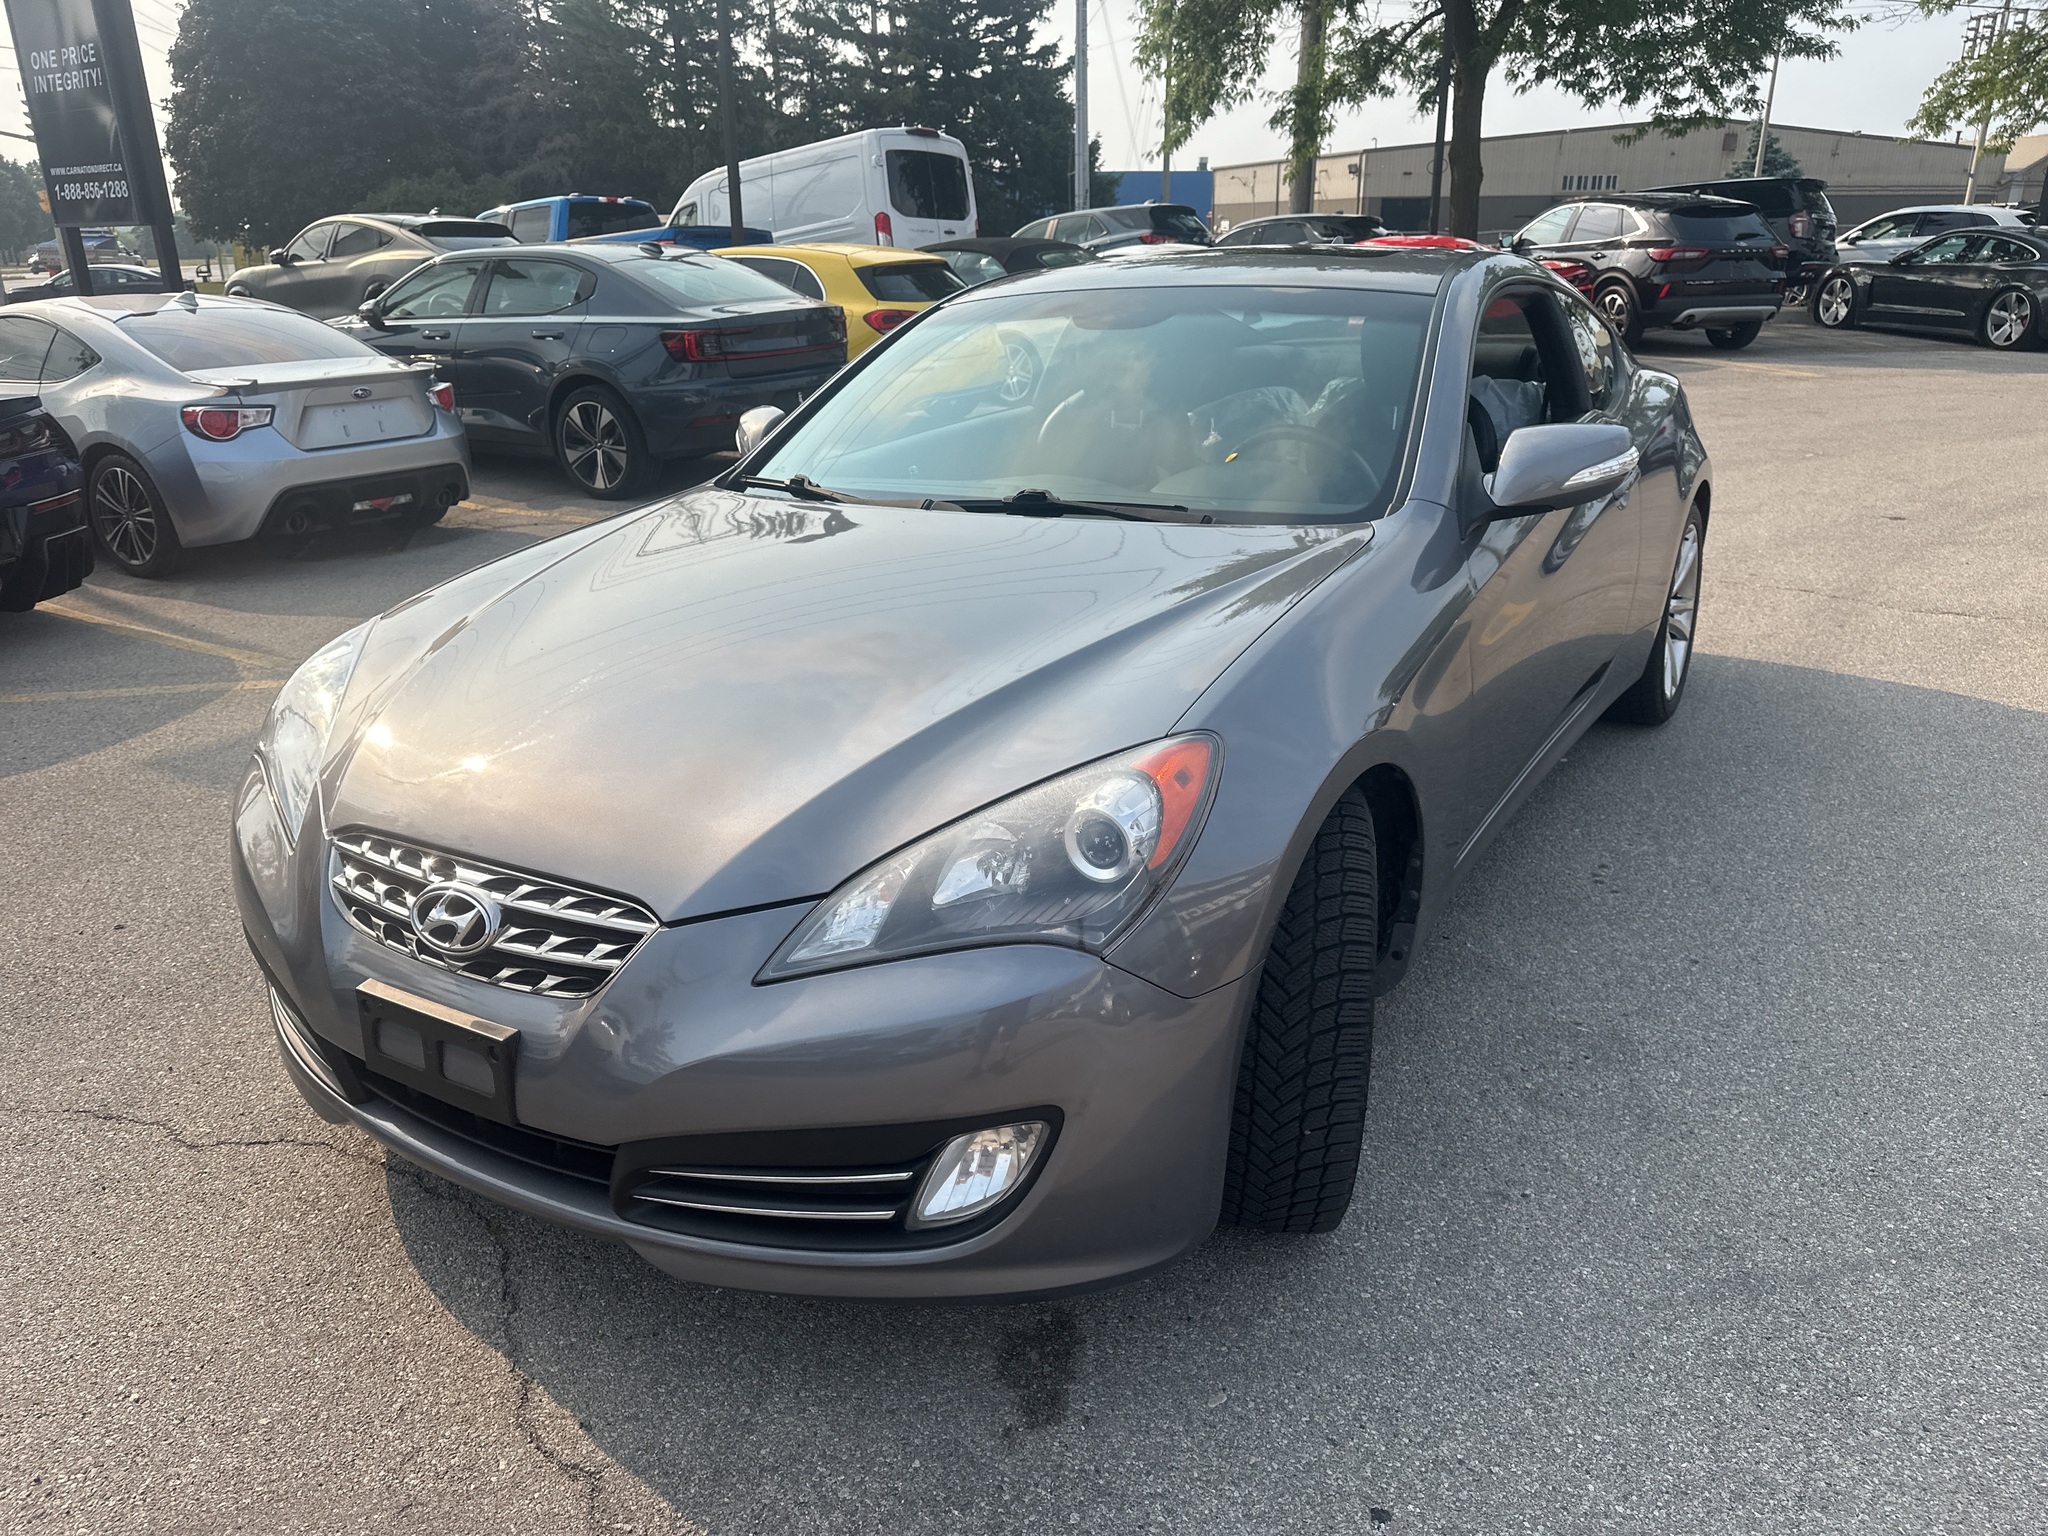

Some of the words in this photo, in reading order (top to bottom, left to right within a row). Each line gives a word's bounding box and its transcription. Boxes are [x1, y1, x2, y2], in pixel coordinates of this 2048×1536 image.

[31, 49, 57, 70] ONE
[61, 43, 96, 66] PRICE
[34, 68, 102, 94] INTEGRITY!
[50, 163, 122, 176] WWW.CARNATIONDIRECT.CA
[55, 180, 128, 200] 1-888-856-1288
